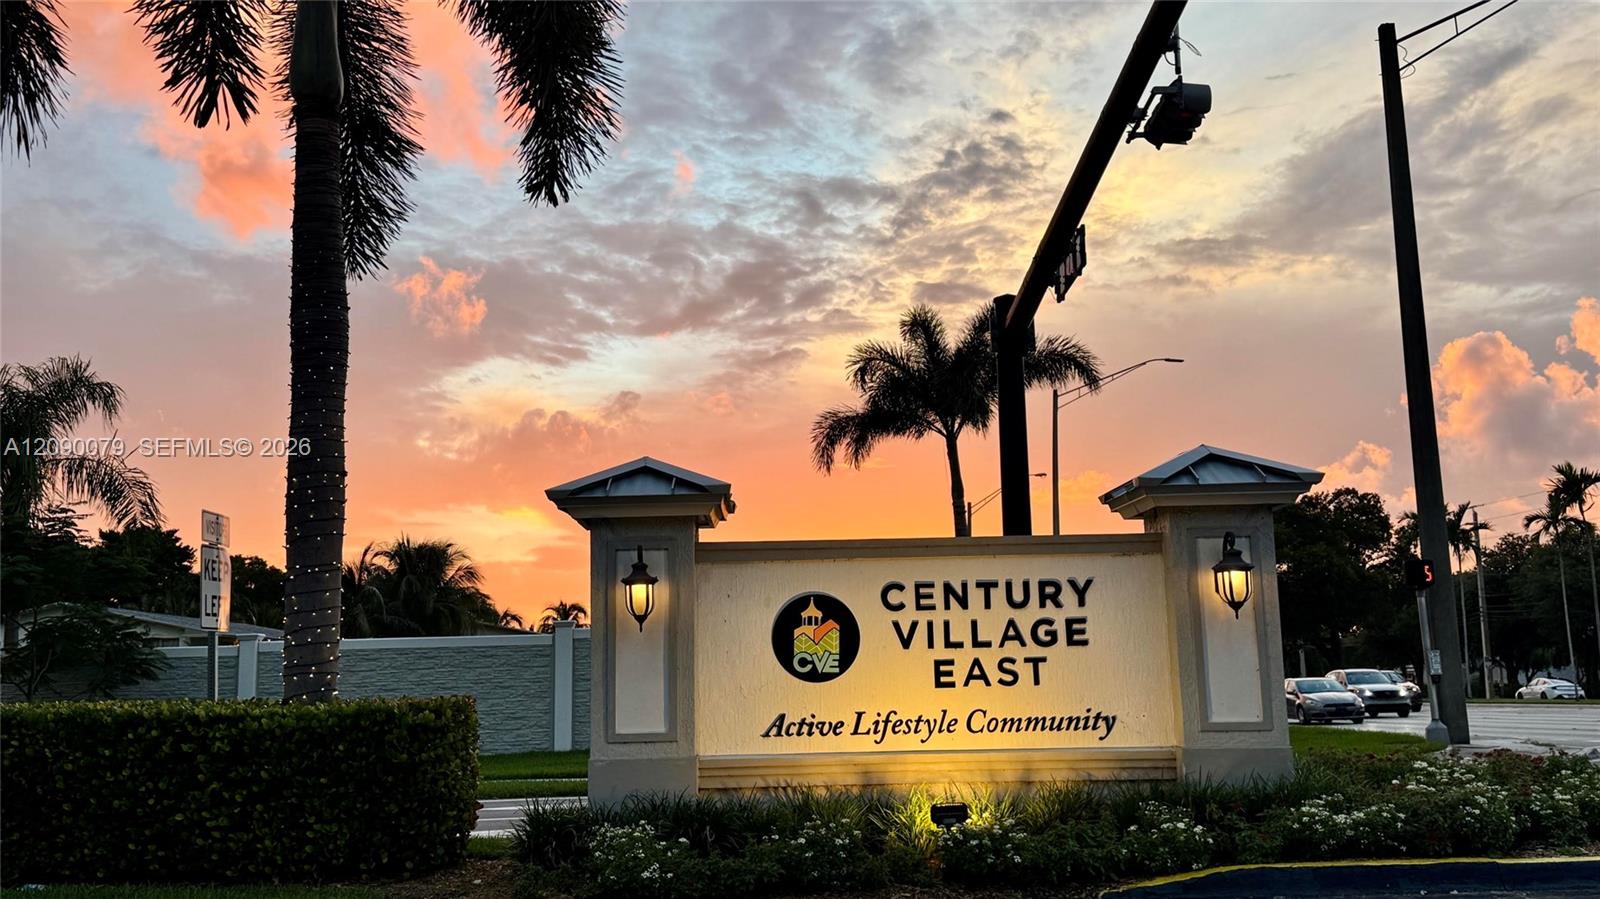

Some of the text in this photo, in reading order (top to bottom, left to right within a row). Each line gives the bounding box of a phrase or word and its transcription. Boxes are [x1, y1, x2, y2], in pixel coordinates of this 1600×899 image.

[204, 559, 229, 583] KEEP
[880, 577, 1095, 612] CENTURY
[891, 616, 1090, 650] VILLAGE
[792, 649, 840, 675] CVE
[933, 656, 1048, 689] EAST
[759, 707, 1118, 745] Active Lifestyle Community
